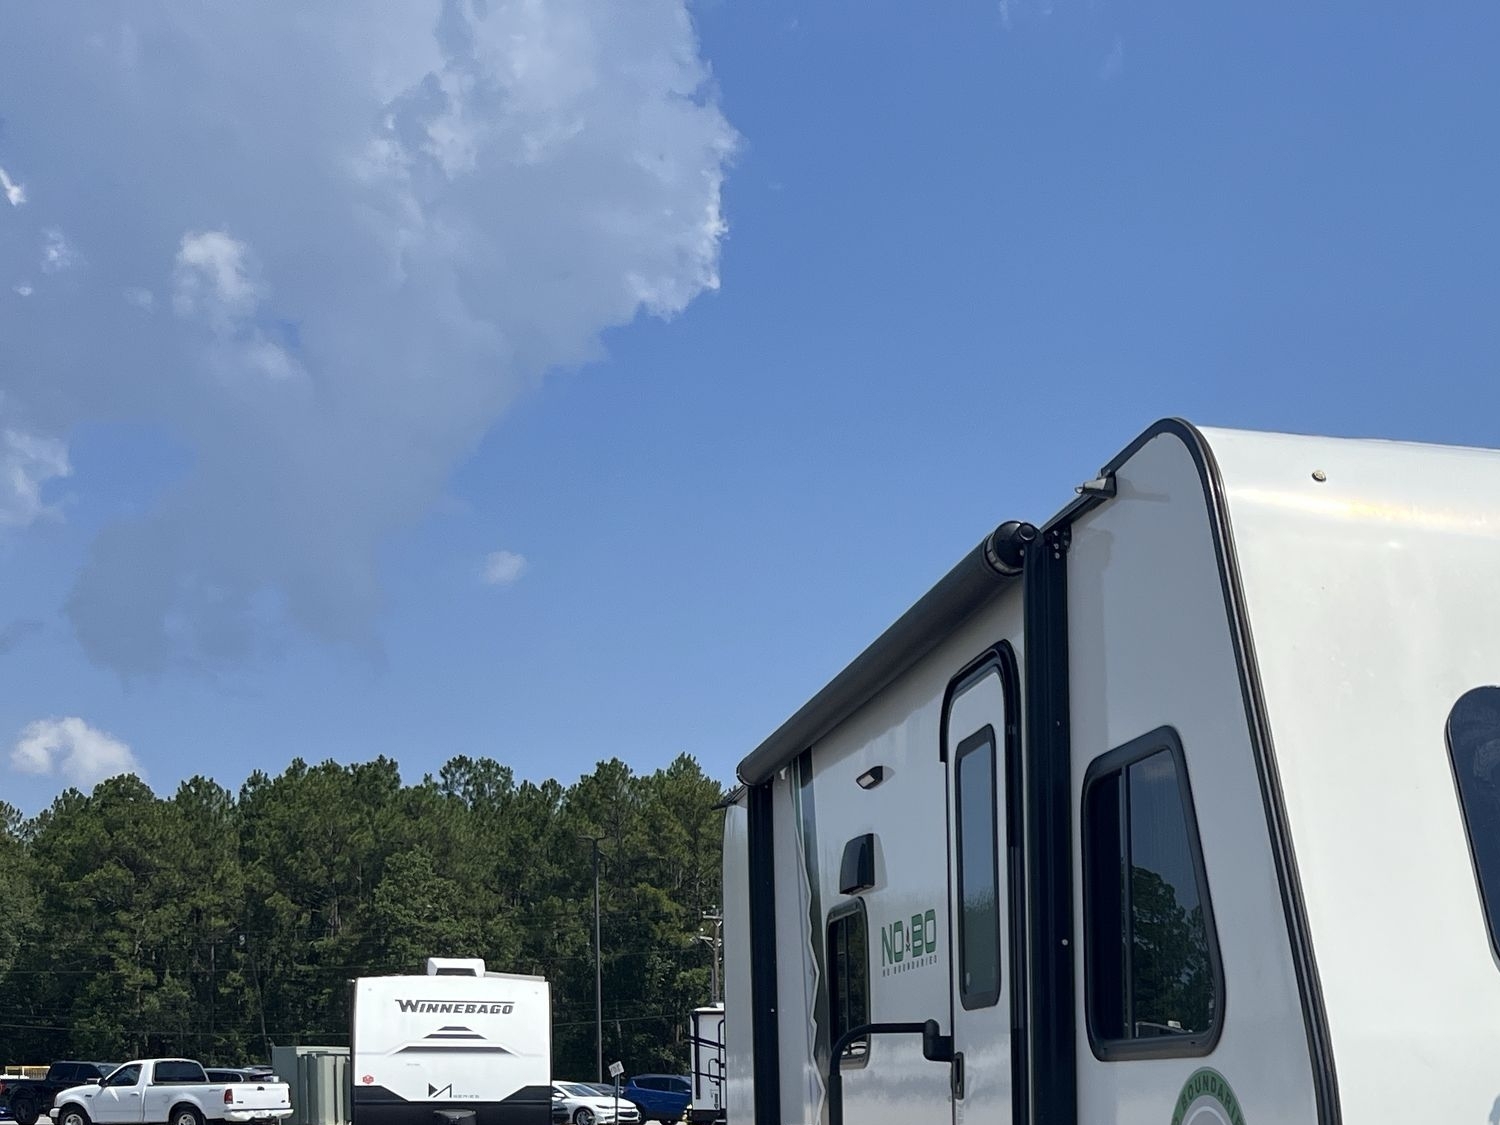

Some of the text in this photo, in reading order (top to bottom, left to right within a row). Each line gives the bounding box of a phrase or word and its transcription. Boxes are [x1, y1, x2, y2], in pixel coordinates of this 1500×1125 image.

[881, 909, 937, 967] NO BO
[394, 999, 515, 1015] WINNEBAGO
